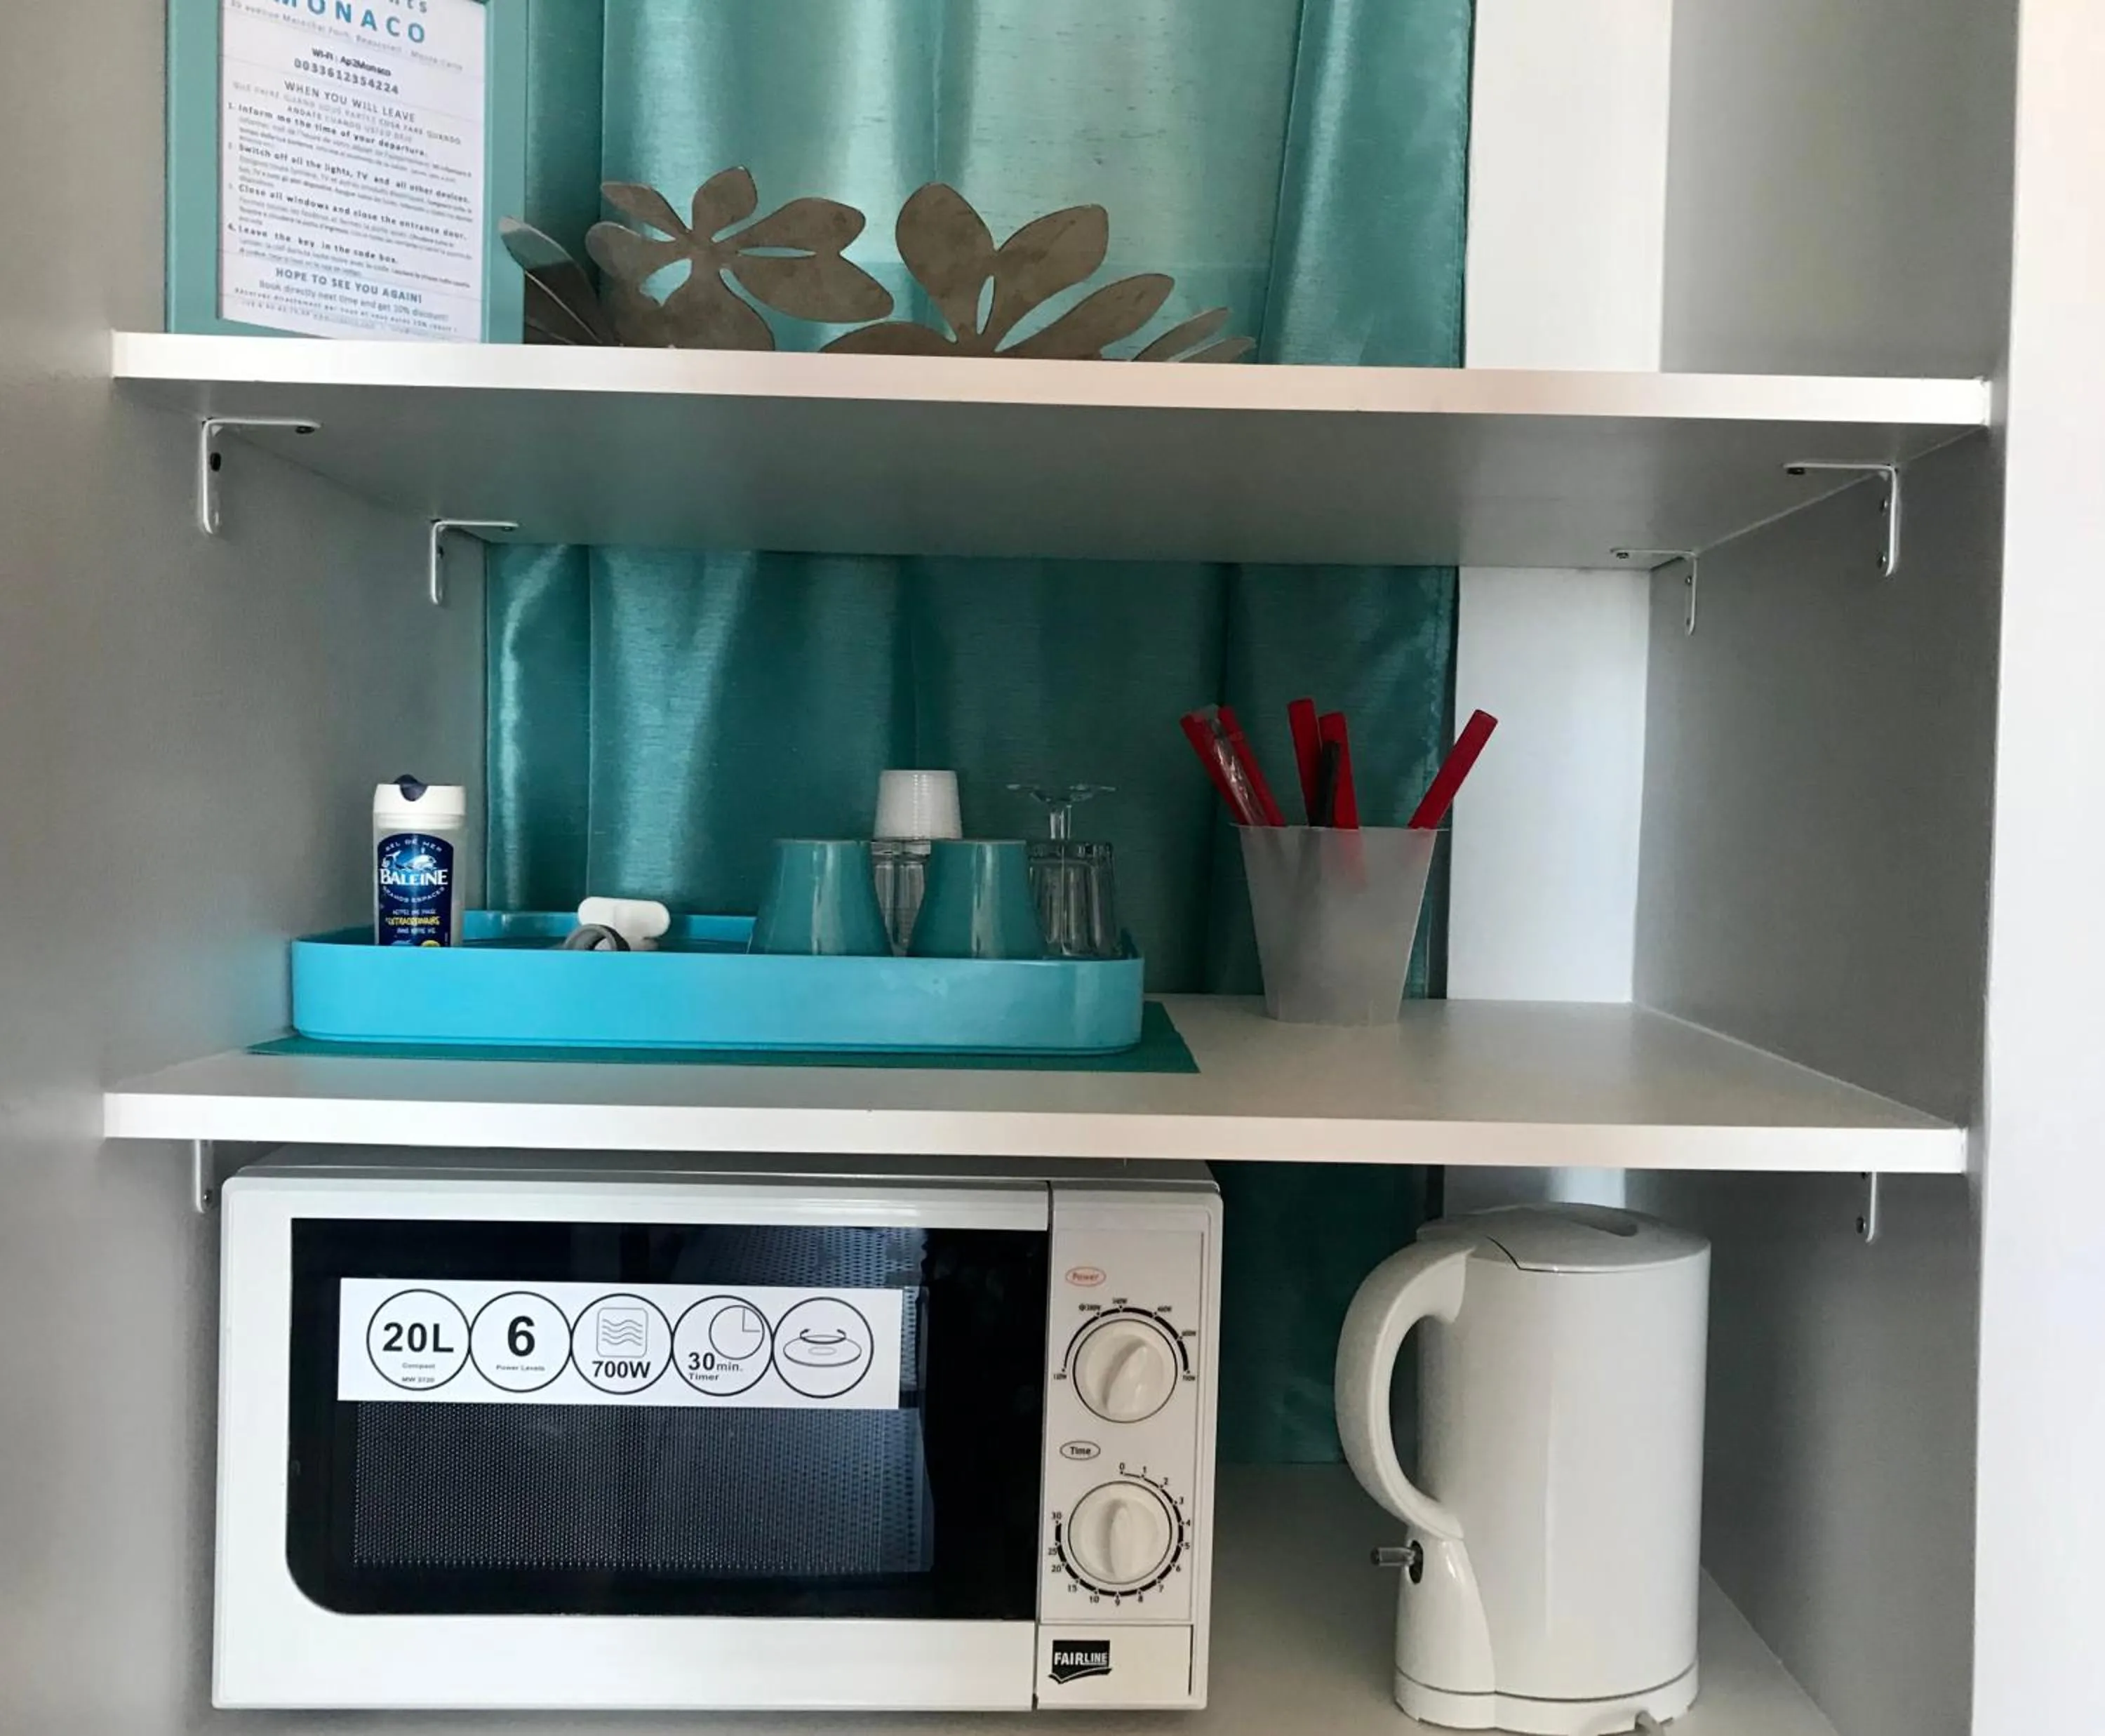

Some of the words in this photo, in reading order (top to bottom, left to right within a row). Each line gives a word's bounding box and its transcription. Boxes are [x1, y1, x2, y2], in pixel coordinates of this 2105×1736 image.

[284, 80, 320, 98] WHEN
[323, 91, 348, 105] YOU
[352, 98, 377, 113] WILL
[382, 106, 416, 123] LEAVE
[238, 104, 274, 119] Inform
[276, 114, 292, 123] me
[294, 118, 312, 129] the
[315, 123, 337, 135] time
[340, 128, 351, 138] of
[353, 133, 375, 145] your
[239, 142, 272, 158] Switch
[274, 152, 288, 162] off
[291, 156, 303, 166] all
[306, 159, 321, 170] the
[356, 171, 369, 181] TV
[373, 176, 390, 186] and
[395, 181, 407, 189] all
[409, 184, 434, 195] other
[238, 183, 267, 197] Close
[269, 192, 283, 201] all
[286, 196, 330, 211] windows
[333, 205, 352, 215] and
[352, 210, 378, 222] close
[380, 215, 397, 226] the
[399, 220, 441, 235] entrance
[238, 225, 269, 238] Leave
[274, 232, 292, 243] the
[298, 236, 315, 248] key
[321, 241, 331, 251] in
[333, 245, 351, 255] the
[353, 248, 377, 260] code
[275, 267, 308, 282] HOPE
[311, 274, 328, 286] TO
[331, 278, 351, 291] SEE
[354, 281, 380, 296] YOU
[382, 288, 422, 305] AGAIN!
[283, 285, 316, 299] directly
[360, 299, 377, 310] and
[380, 867, 449, 886] BALEINE
[1072, 1271, 1100, 1281] Power
[382, 1321, 455, 1354] 20L
[507, 1315, 536, 1357] 6
[688, 1351, 716, 1371] 30
[592, 1361, 651, 1380] 700W
[688, 1373, 720, 1381] Timer
[1069, 1446, 1092, 1455] Time
[1119, 1462, 1125, 1471] 0
[1163, 1476, 1169, 1485] 2
[1180, 1496, 1184, 1505] 3
[1052, 1511, 1062, 1520] 30
[1184, 1542, 1191, 1550] 5
[1048, 1547, 1057, 1556] 25
[1051, 1564, 1062, 1573] 20
[1175, 1564, 1182, 1573] 6
[1067, 1584, 1078, 1593] 15
[1159, 1584, 1165, 1594] 7
[1089, 1595, 1100, 1603] 10
[1114, 1597, 1121, 1607] 9
[1137, 1594, 1144, 1603] 8
[1054, 1651, 1109, 1666] FAIRLINE
